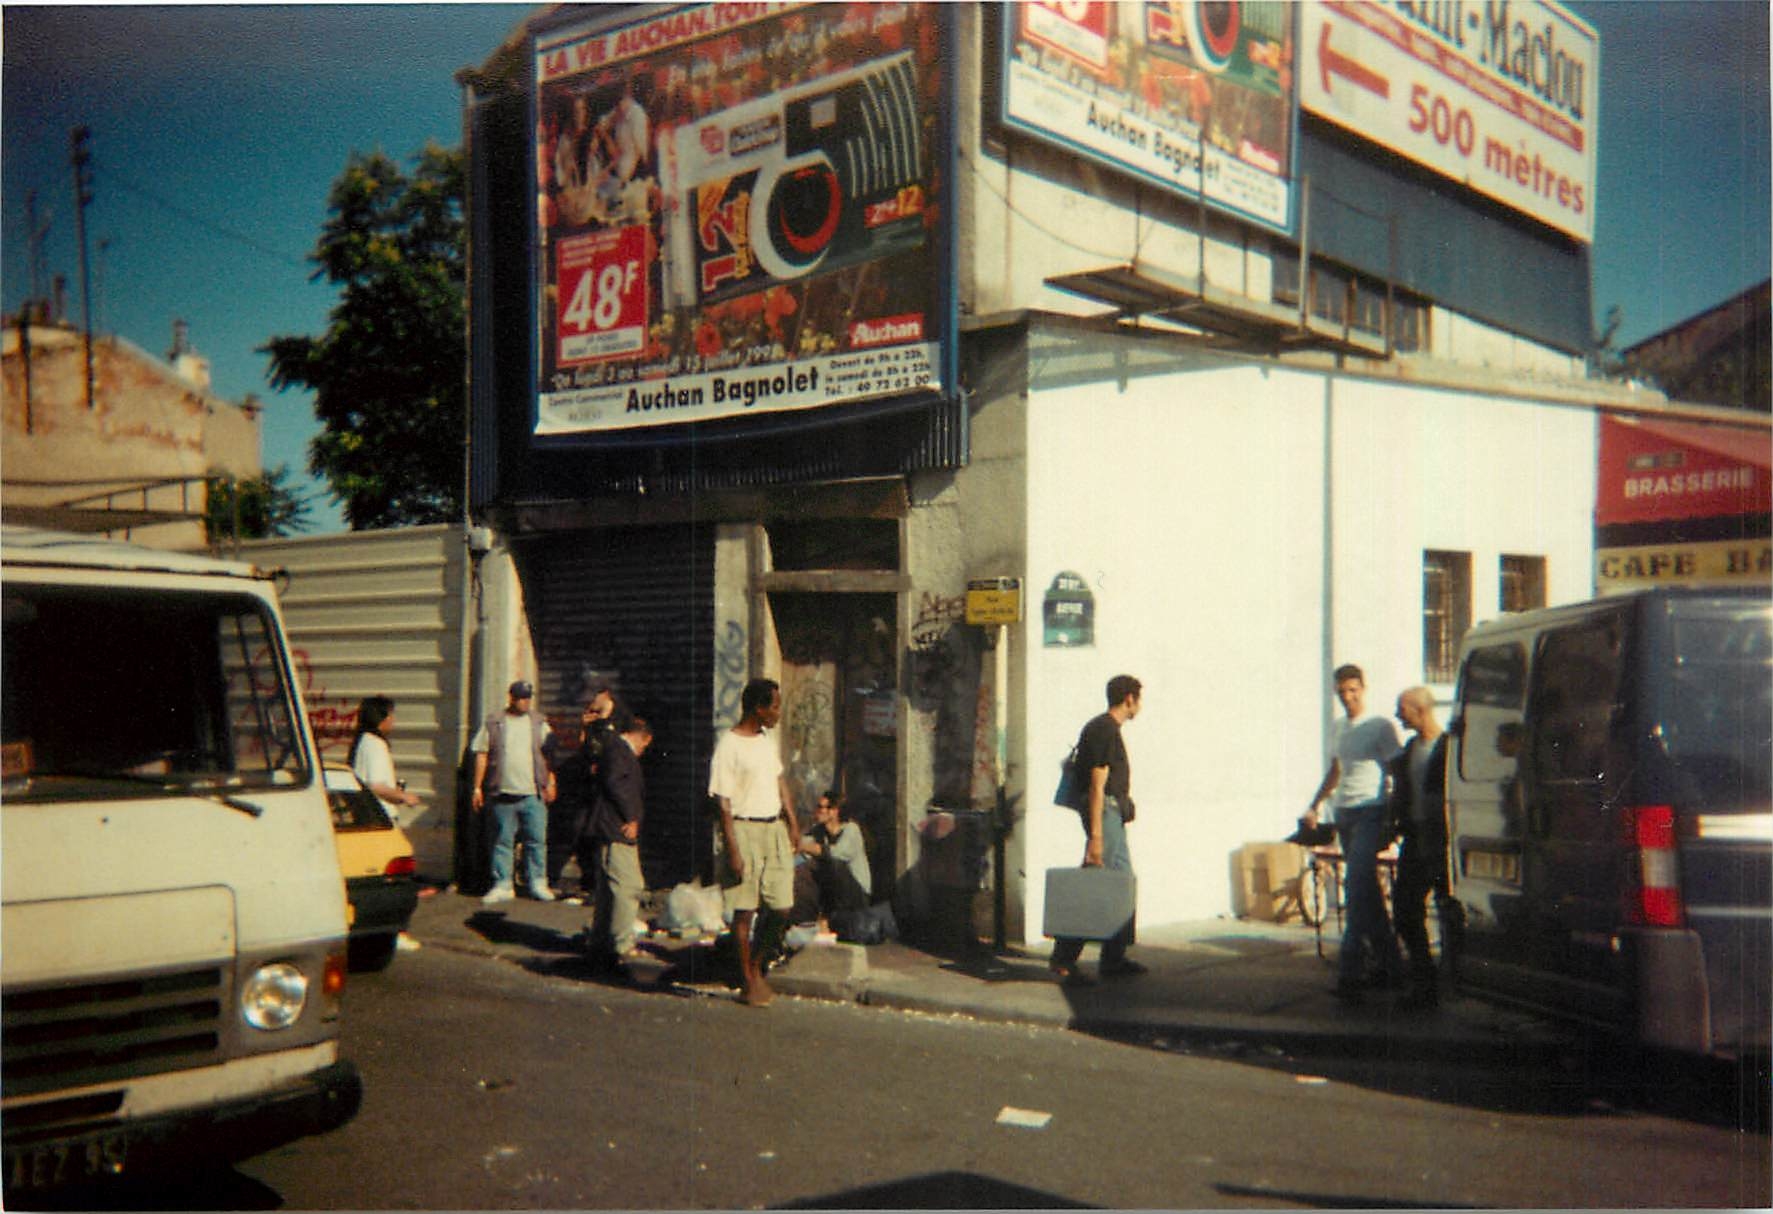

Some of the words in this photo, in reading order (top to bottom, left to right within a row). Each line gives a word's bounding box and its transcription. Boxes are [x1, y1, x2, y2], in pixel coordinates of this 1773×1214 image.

[545, 50, 569, 76] LA
[574, 37, 606, 65] VIE
[1087, 100, 1147, 151] Auchan
[1154, 130, 1220, 180] Bagnoet
[1408, 83, 1475, 158] 500
[1485, 134, 1585, 215] mètres
[853, 321, 921, 345] Auchan
[626, 382, 704, 413] Auchan
[713, 365, 819, 406] Bagnolet
[1624, 466, 1754, 498] BRASSERIE
